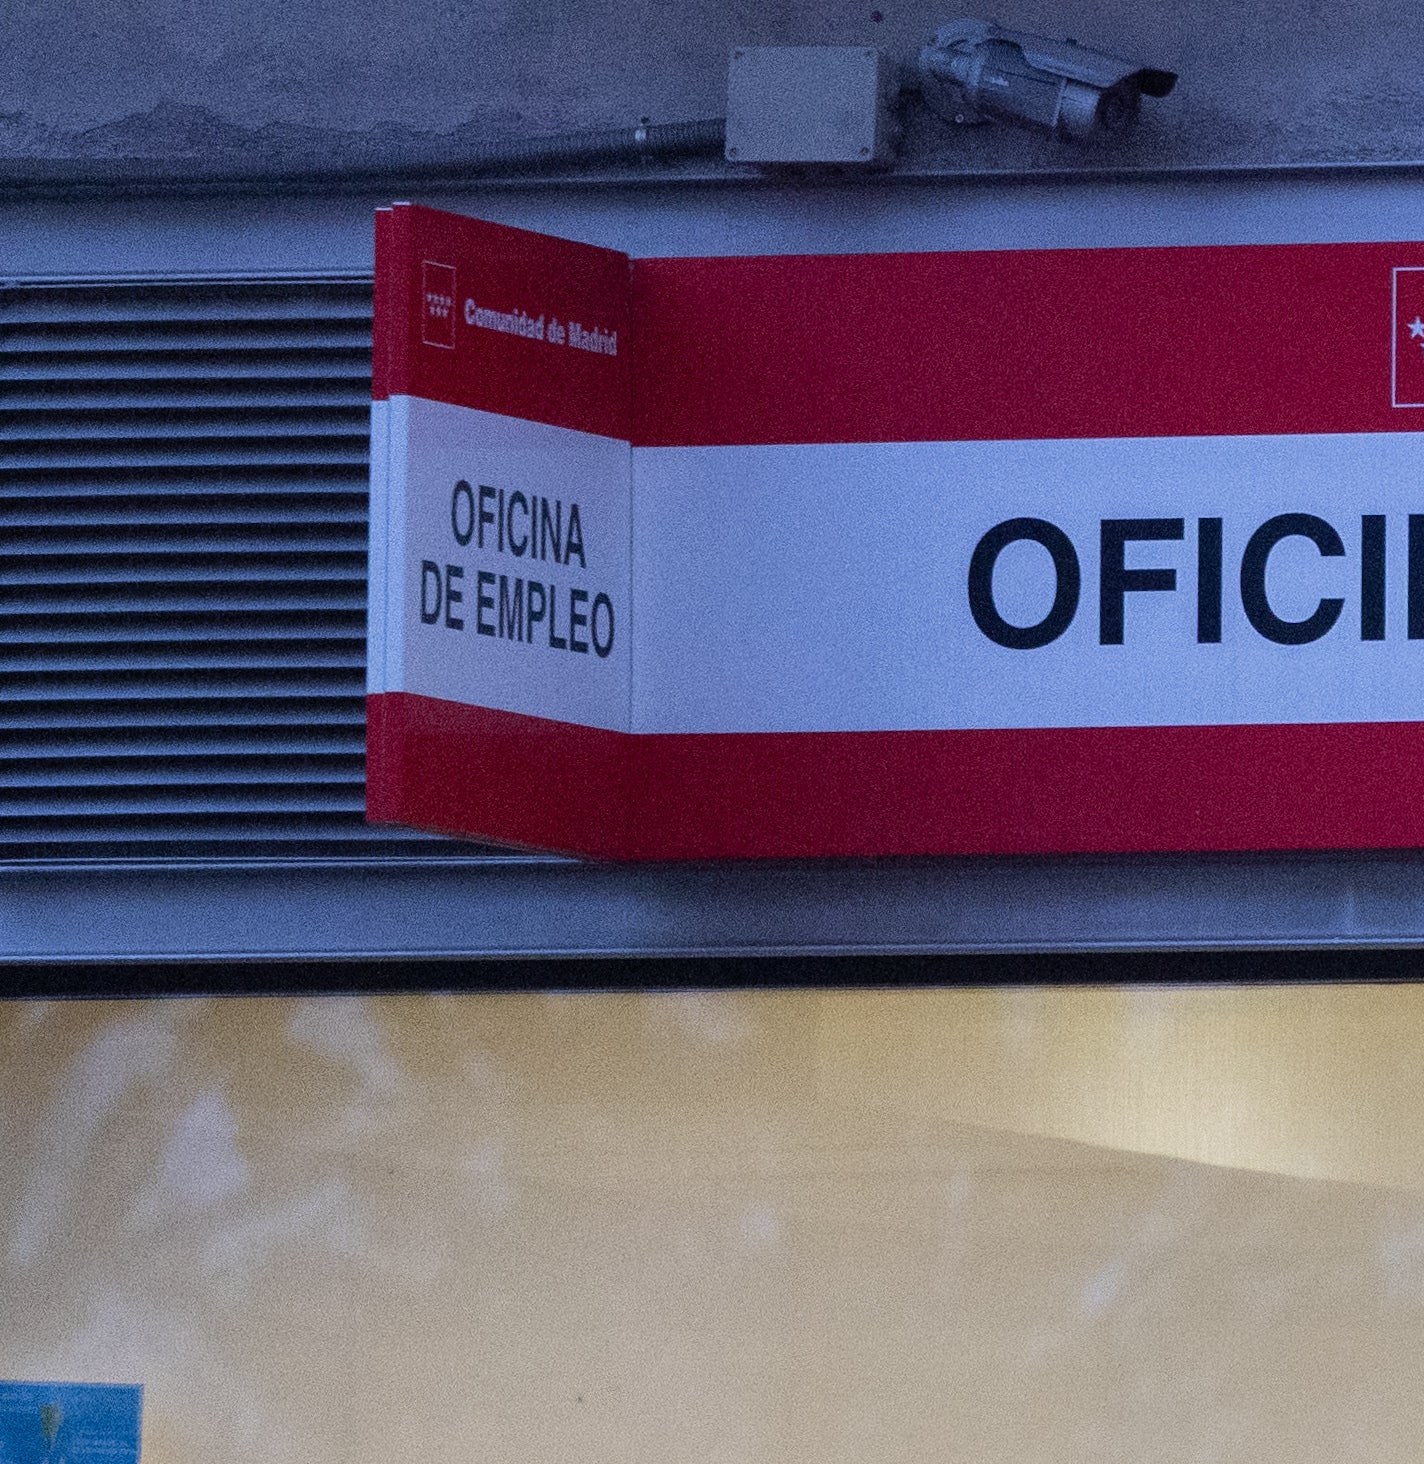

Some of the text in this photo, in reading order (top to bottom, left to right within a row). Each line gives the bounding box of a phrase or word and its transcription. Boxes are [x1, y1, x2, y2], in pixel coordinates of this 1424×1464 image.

[465, 298, 617, 356] Comunidad de Madrid
[452, 479, 587, 569] OFICINA
[421, 560, 614, 658] DE EMPLEO
